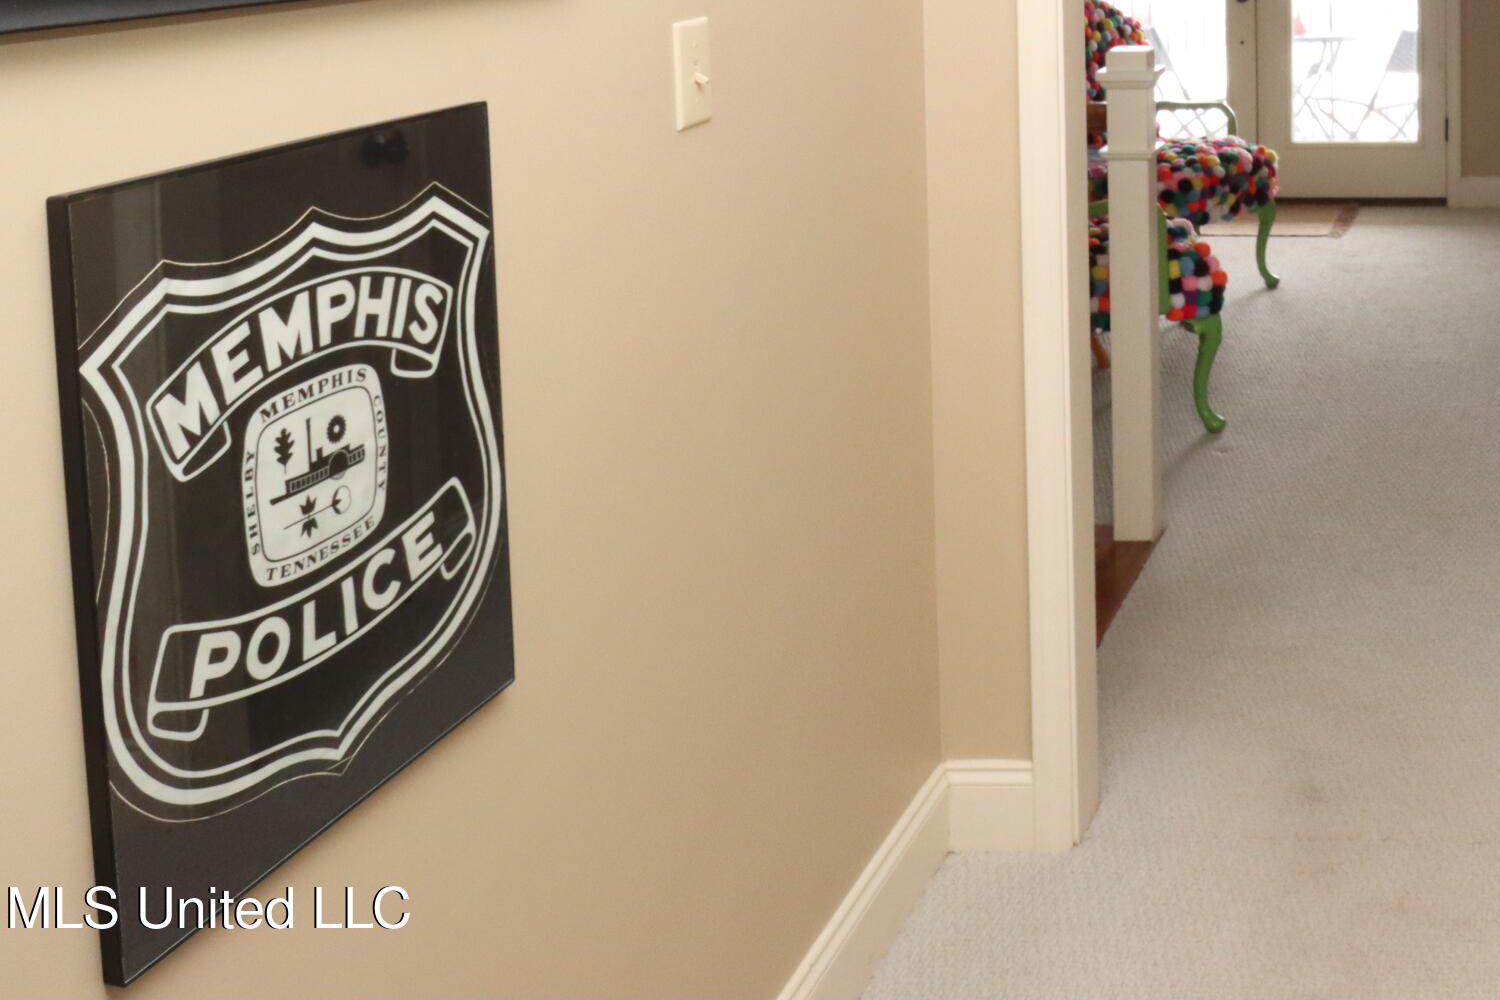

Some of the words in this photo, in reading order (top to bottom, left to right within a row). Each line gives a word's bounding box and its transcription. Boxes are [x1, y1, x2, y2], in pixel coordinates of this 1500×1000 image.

[154, 275, 444, 460] MEMPHIS
[259, 368, 367, 425] MEMPHIS
[374, 394, 388, 491] COUNTY
[244, 449, 263, 556] SHELBY
[265, 515, 376, 583] TENNESSEE
[189, 510, 444, 700] POLICE
